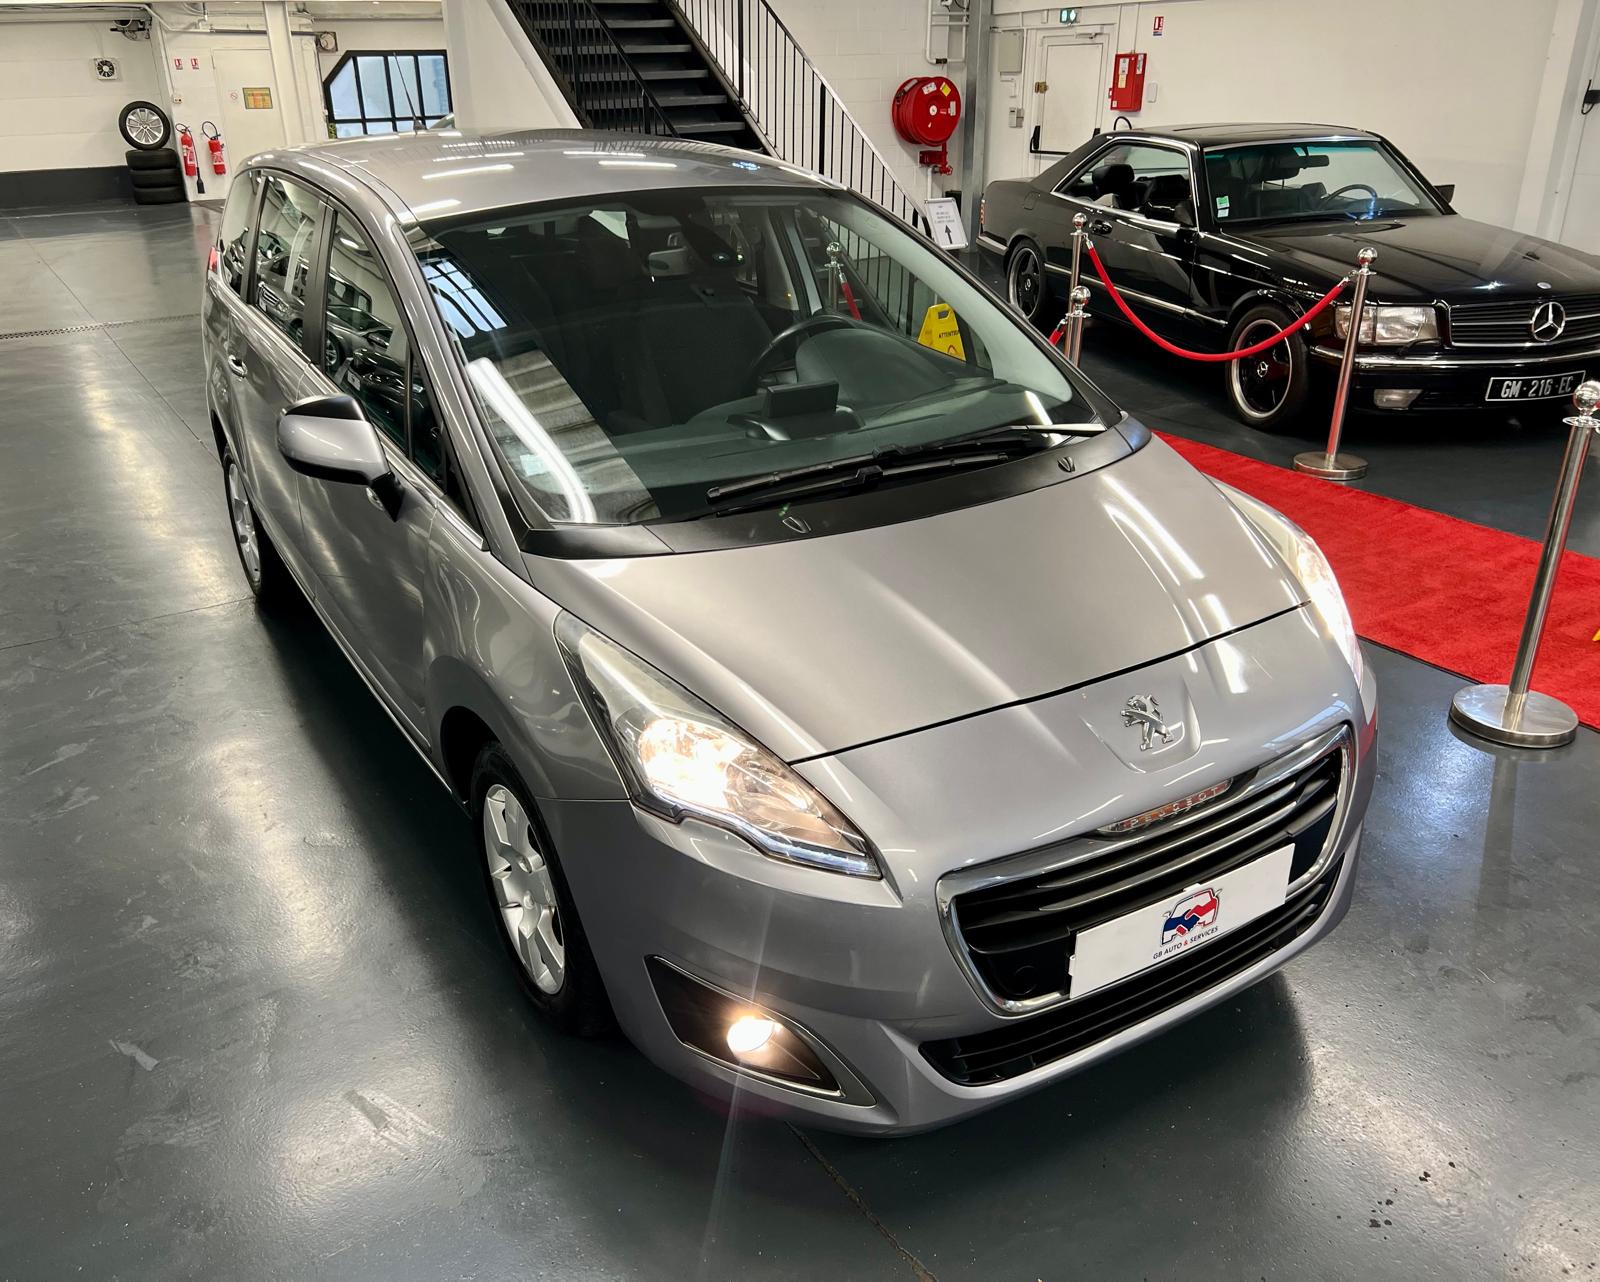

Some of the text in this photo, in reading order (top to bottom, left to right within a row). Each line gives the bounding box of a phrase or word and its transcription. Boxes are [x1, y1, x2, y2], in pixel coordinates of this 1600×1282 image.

[1153, 950, 1163, 960] GB
[1164, 942, 1182, 956] AUTO
[1190, 926, 1218, 943] SERVICES
